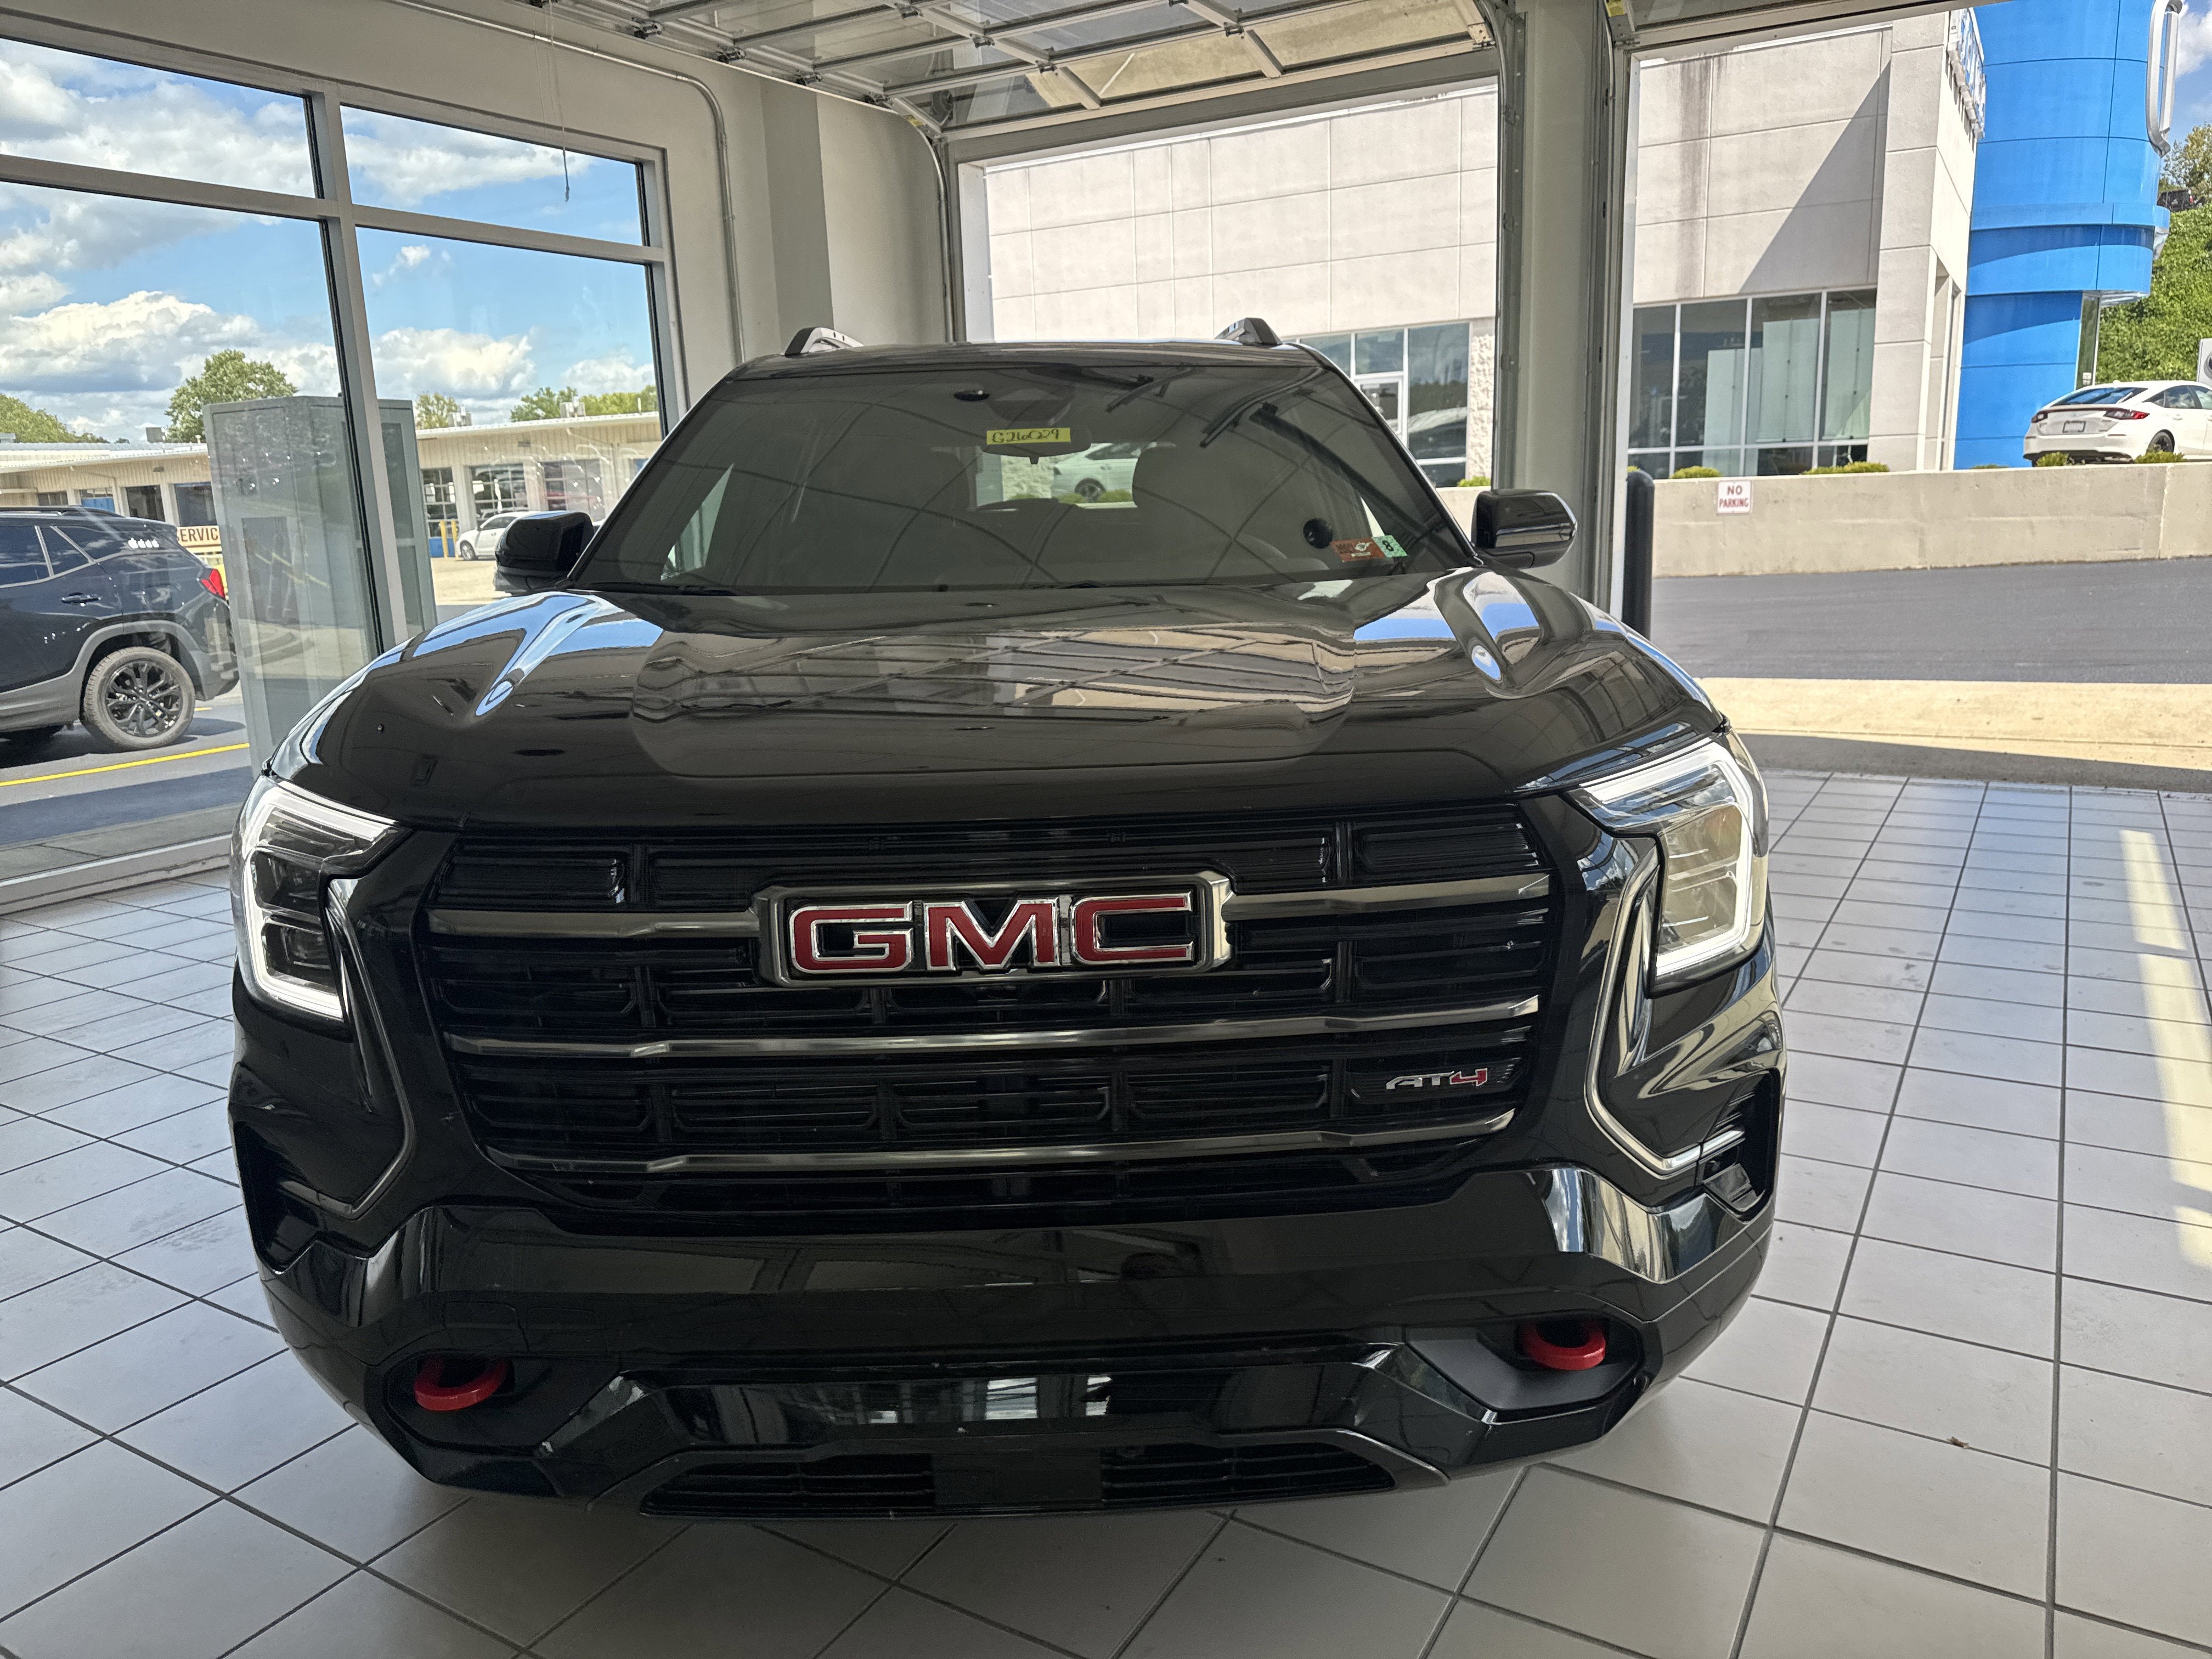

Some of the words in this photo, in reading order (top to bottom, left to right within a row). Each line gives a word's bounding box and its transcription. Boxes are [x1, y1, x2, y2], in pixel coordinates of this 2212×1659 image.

[1728, 484, 1742, 495] NO
[1719, 498, 1748, 507] PARKING
[177, 527, 218, 541] ERVIC
[1382, 540, 1394, 552] 8
[789, 890, 1193, 974] GMC
[1386, 1068, 1488, 1090] AT4
